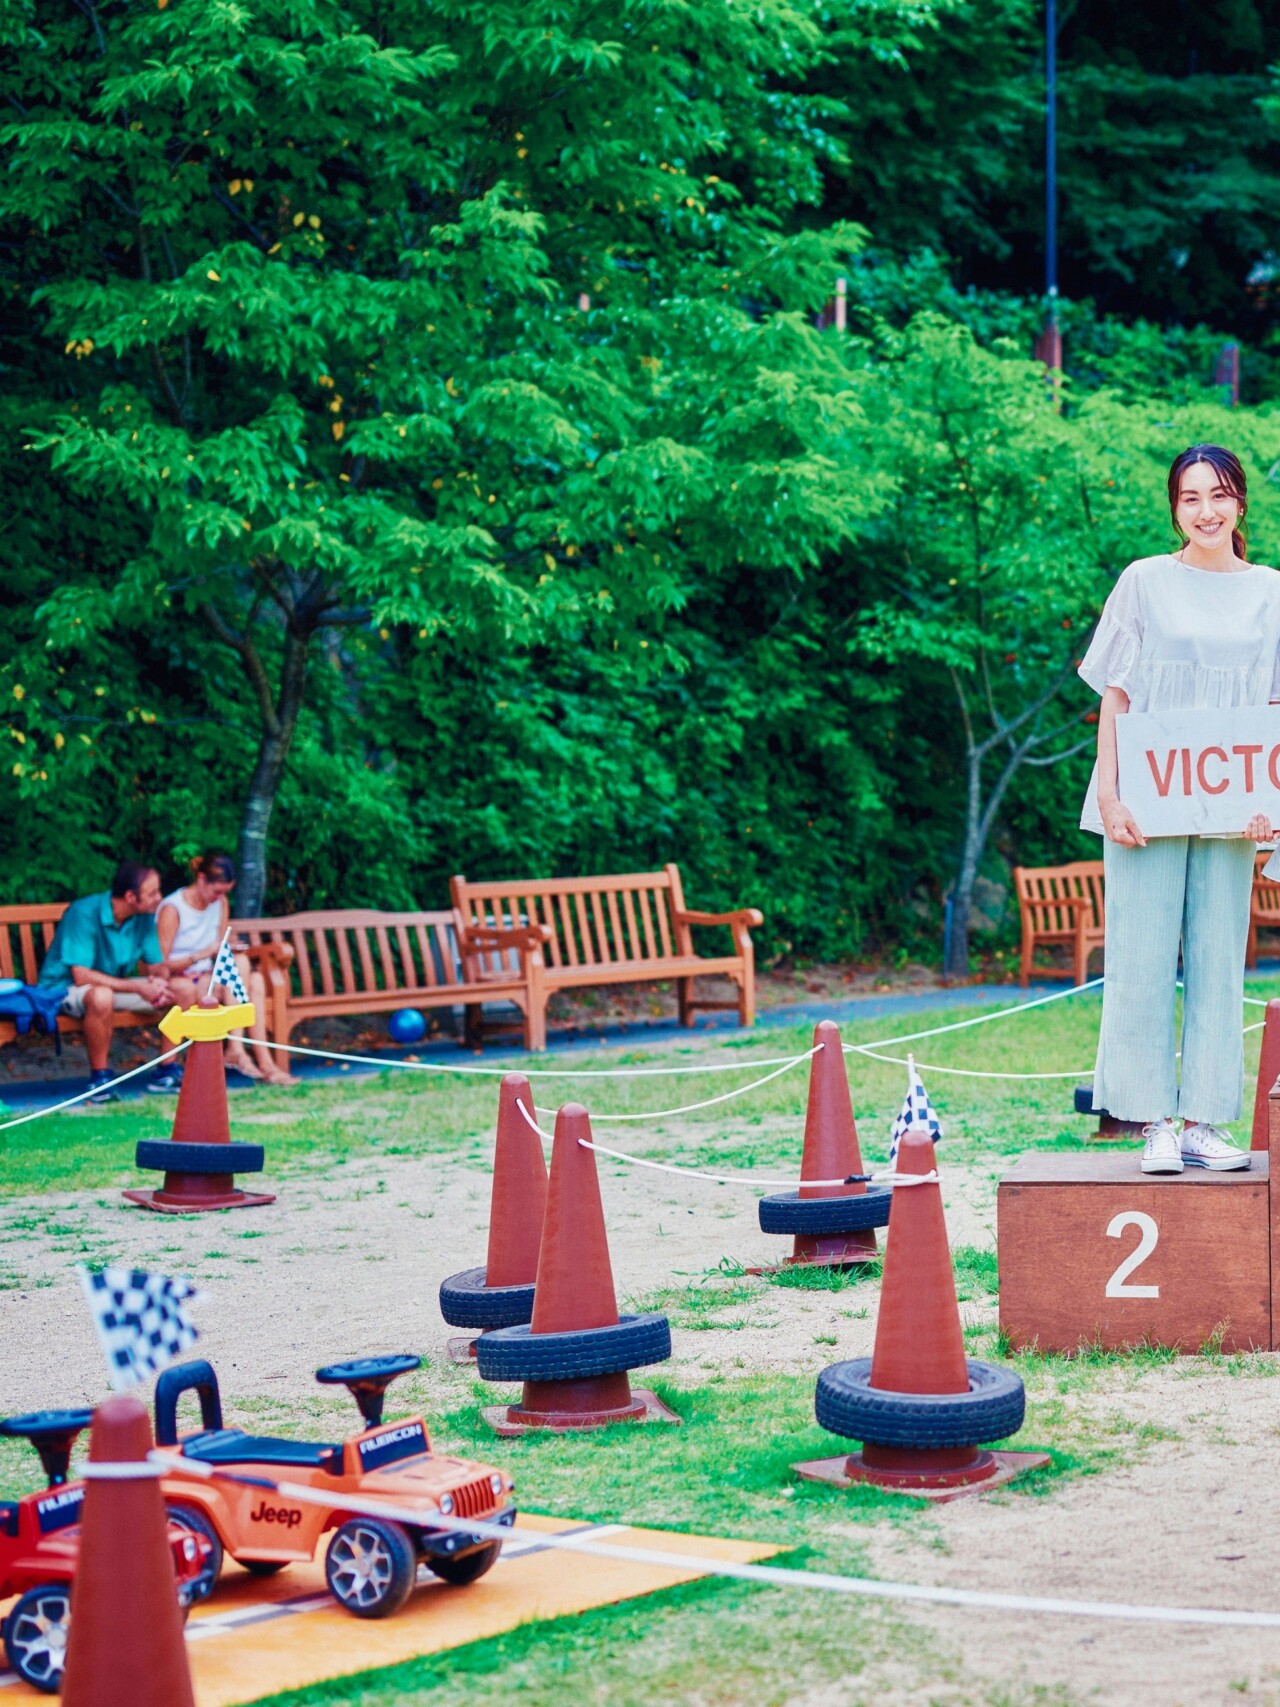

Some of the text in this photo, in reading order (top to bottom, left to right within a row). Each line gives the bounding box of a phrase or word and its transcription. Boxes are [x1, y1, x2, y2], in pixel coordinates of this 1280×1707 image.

[1105, 1211, 1160, 1299] 2
[359, 1424, 422, 1454] RUBICON
[250, 1501, 302, 1529] Jeep
